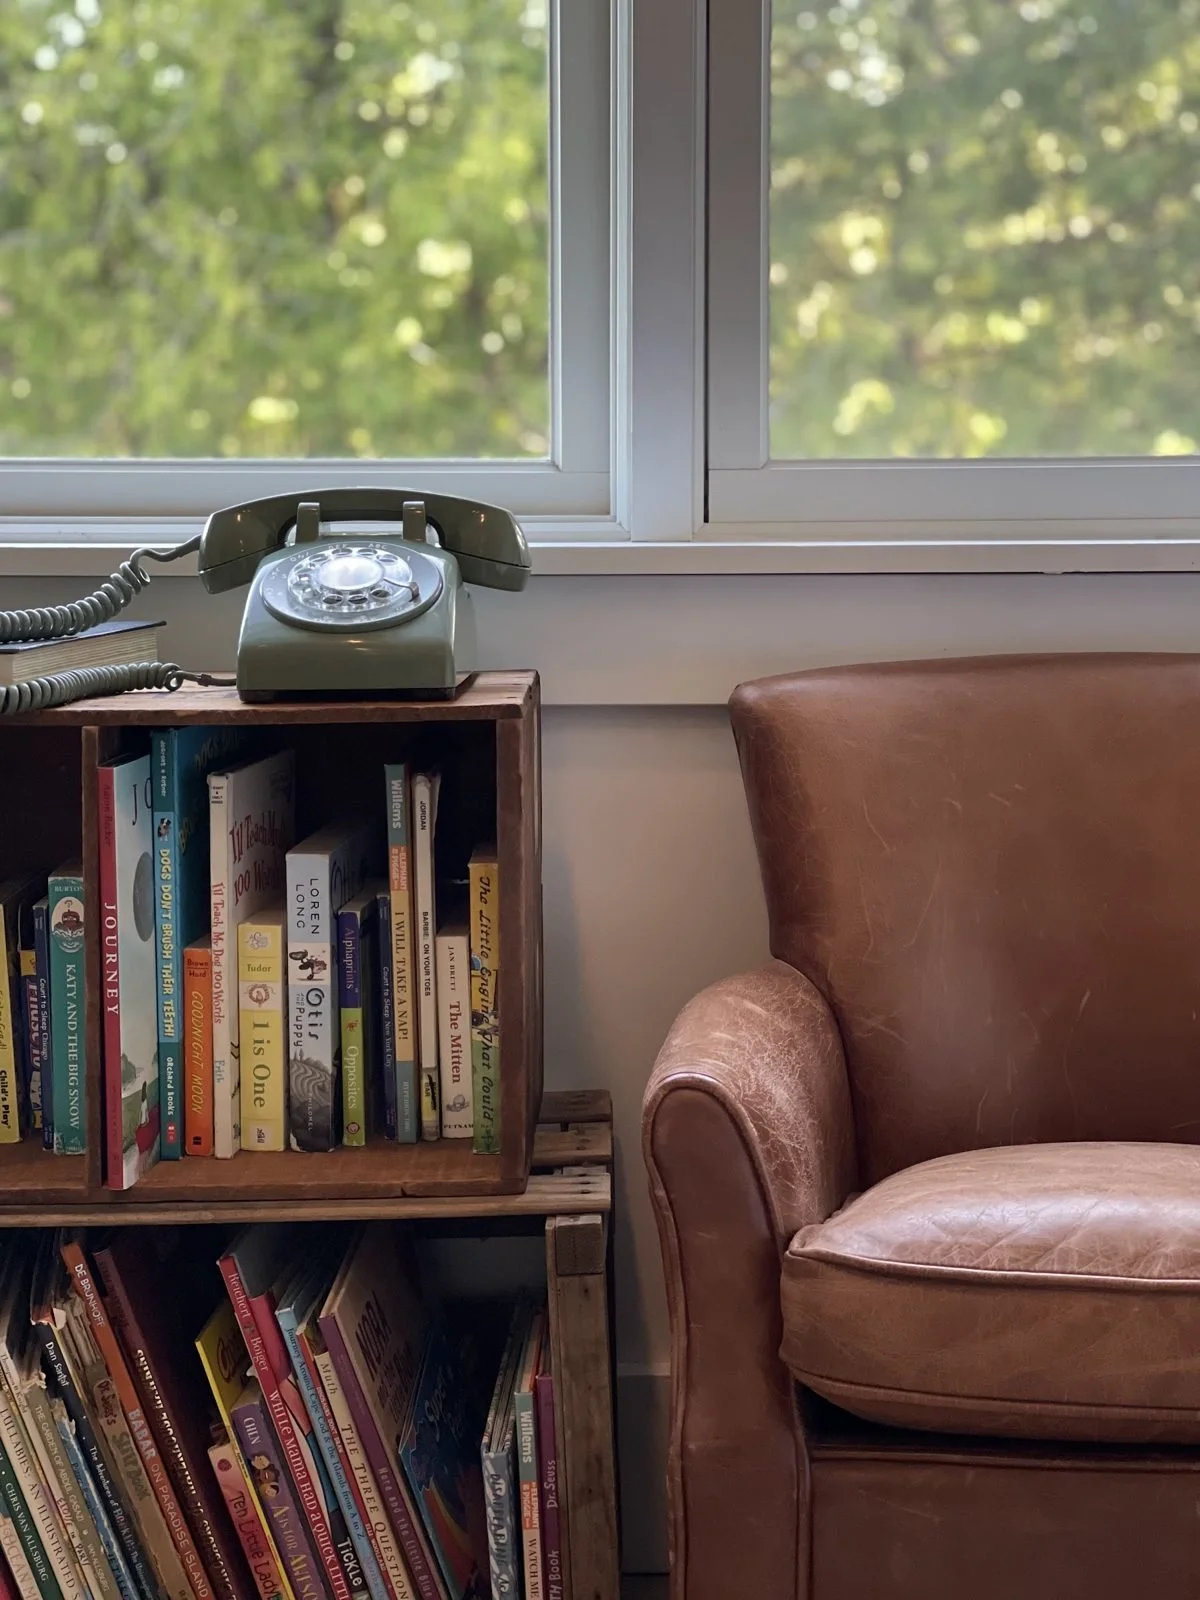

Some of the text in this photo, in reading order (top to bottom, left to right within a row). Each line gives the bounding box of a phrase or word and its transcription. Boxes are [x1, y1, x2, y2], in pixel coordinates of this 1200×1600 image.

[391, 778, 403, 829] Willems
[245, 812, 267, 850] Teach
[160, 848, 171, 879] DOGS
[161, 885, 173, 920] DON'T
[234, 869, 251, 906] 100
[480, 875, 490, 906] The
[212, 900, 224, 928] Teach
[295, 884, 305, 929] LONG
[310, 878, 320, 935] LOREN
[162, 923, 174, 957] BRUSH
[213, 930, 224, 948] My
[395, 919, 405, 952] WILL
[423, 943, 430, 954] ON
[479, 909, 492, 961] Little
[104, 901, 119, 1015] JOURNEY
[213, 950, 224, 967] Dog
[247, 963, 272, 973] Tudor
[344, 927, 355, 990] Alphaprints
[396, 954, 407, 993] TAKE
[162, 962, 174, 995] THEIR
[214, 970, 223, 988] 100
[478, 966, 492, 1024] Engine
[41, 1000, 47, 1009] to
[213, 988, 225, 1024] Words
[306, 987, 325, 1041] Otis
[383, 999, 391, 1018] Sleep
[397, 998, 407, 1009] A
[293, 1006, 305, 1048] Puppy
[398, 1010, 408, 1041] NAP!
[449, 1001, 463, 1084] The Mitten
[66, 963, 80, 1130] KATY AND THE BIG SNOW
[191, 990, 204, 1115] GOODNIGHT MOON
[252, 1039, 271, 1057] is
[384, 1037, 392, 1052] York
[478, 1028, 493, 1070] That
[252, 1064, 271, 1108] One
[347, 1045, 360, 1110] Opposites
[481, 1075, 495, 1121] Could
[74, 1263, 105, 1327] DE BRUNHOFF
[228, 1272, 251, 1319] Reichert
[250, 1337, 269, 1373] Boiger
[45, 1341, 57, 1361] Dan
[286, 1327, 300, 1359] Journey
[299, 1359, 313, 1391] Around
[320, 1363, 338, 1395] Muth
[309, 1392, 320, 1414] Cape
[35, 1406, 46, 1420] THE
[41, 1422, 58, 1455] GARDEN
[54, 1455, 64, 1466] OF
[318, 1415, 328, 1434] Cod
[520, 1410, 532, 1464] Willems
[327, 1445, 335, 1458] the
[341, 1424, 359, 1455] THE
[354, 1462, 379, 1513] THREE
[90, 1446, 98, 1461] The
[95, 1463, 112, 1498] Adventures
[332, 1461, 345, 1490] Islands
[128, 1408, 156, 1460] BABAR
[151, 1463, 162, 1484] ON
[158, 1486, 190, 1548] PARADISE
[184, 1550, 209, 1598] ISLAND
[229, 1490, 249, 1517] Ten
[342, 1490, 353, 1511] from
[5, 1482, 21, 1512] CHRIS
[17, 1512, 30, 1532] VAN
[24, 1534, 49, 1581] ALLSBURG
[28, 1482, 40, 1500] AN
[37, 1504, 75, 1588] ILLUSTRATED
[238, 1519, 264, 1560] Little
[271, 1505, 290, 1518] A
[283, 1530, 298, 1550] FOR
[353, 1520, 360, 1529] to
[356, 1531, 364, 1540] Z
[315, 1522, 338, 1566] QUICK
[528, 1538, 539, 1600] WATCH ME
